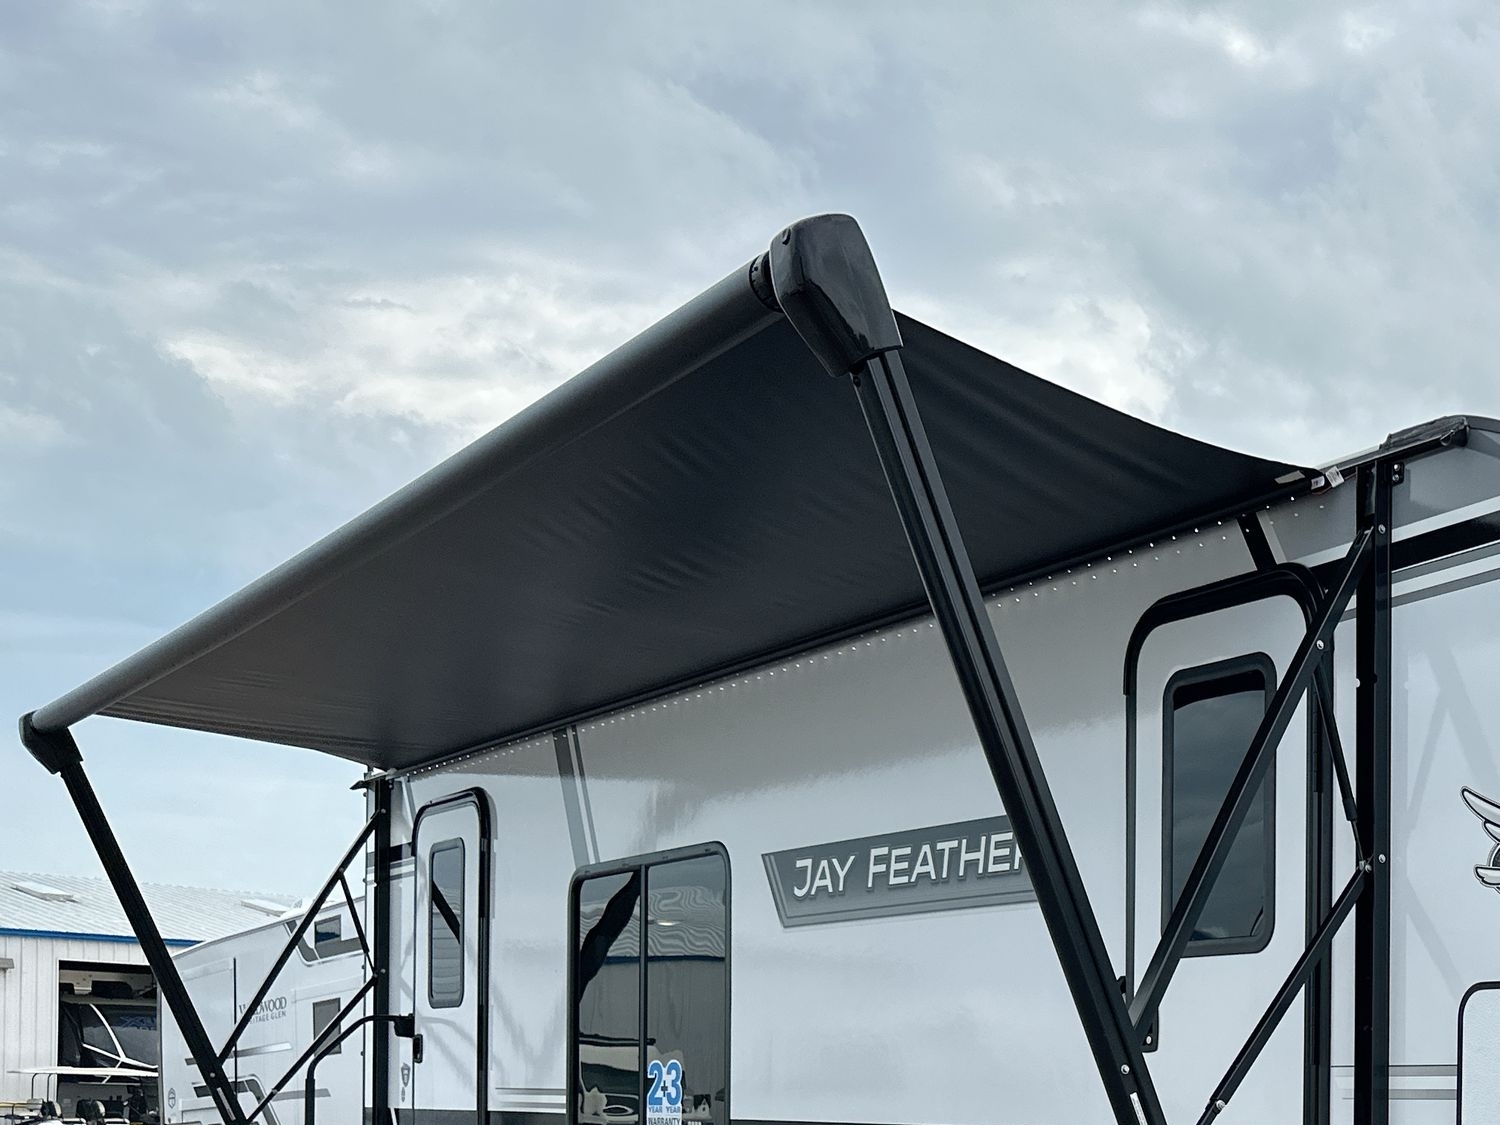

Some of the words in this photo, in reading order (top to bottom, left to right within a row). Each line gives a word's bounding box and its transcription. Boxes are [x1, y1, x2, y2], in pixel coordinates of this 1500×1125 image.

[793, 854, 856, 898] JAY
[648, 1106, 663, 1114] YEAR
[665, 1106, 681, 1114] YEAR
